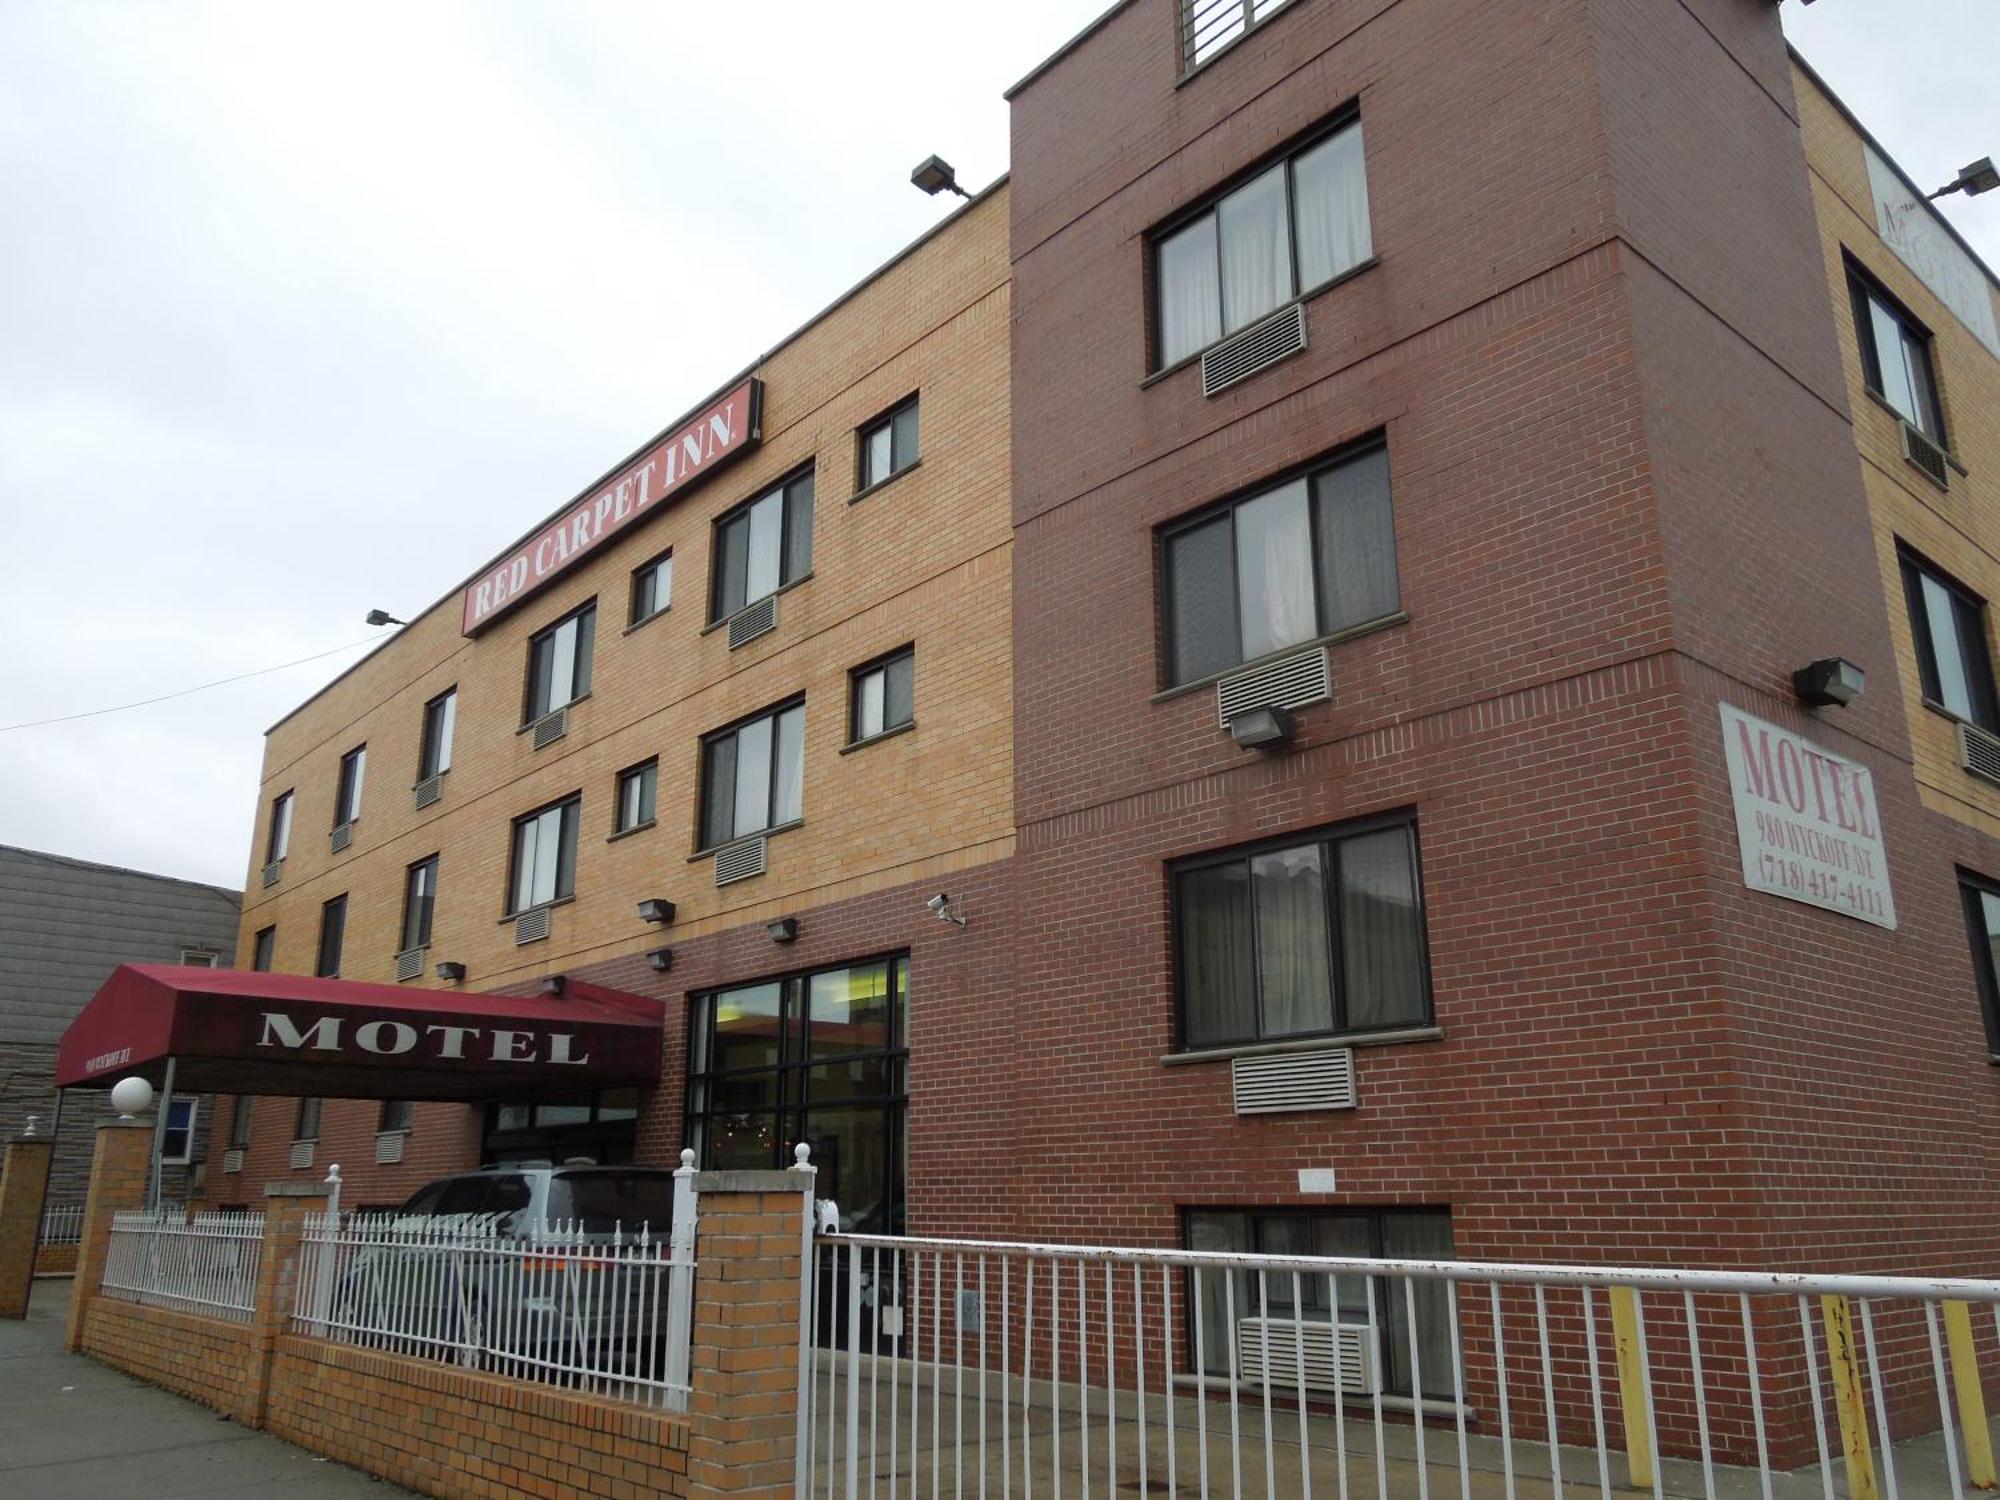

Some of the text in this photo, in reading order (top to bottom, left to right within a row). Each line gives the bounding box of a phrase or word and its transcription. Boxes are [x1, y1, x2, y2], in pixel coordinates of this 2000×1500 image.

[474, 403, 734, 620] RED CARPET INN
[1736, 718, 1877, 841] MOTEL
[1756, 810, 1785, 849] 980
[1759, 848, 1885, 917] (718) 417-4111
[256, 1012, 590, 1065] MOTEL
